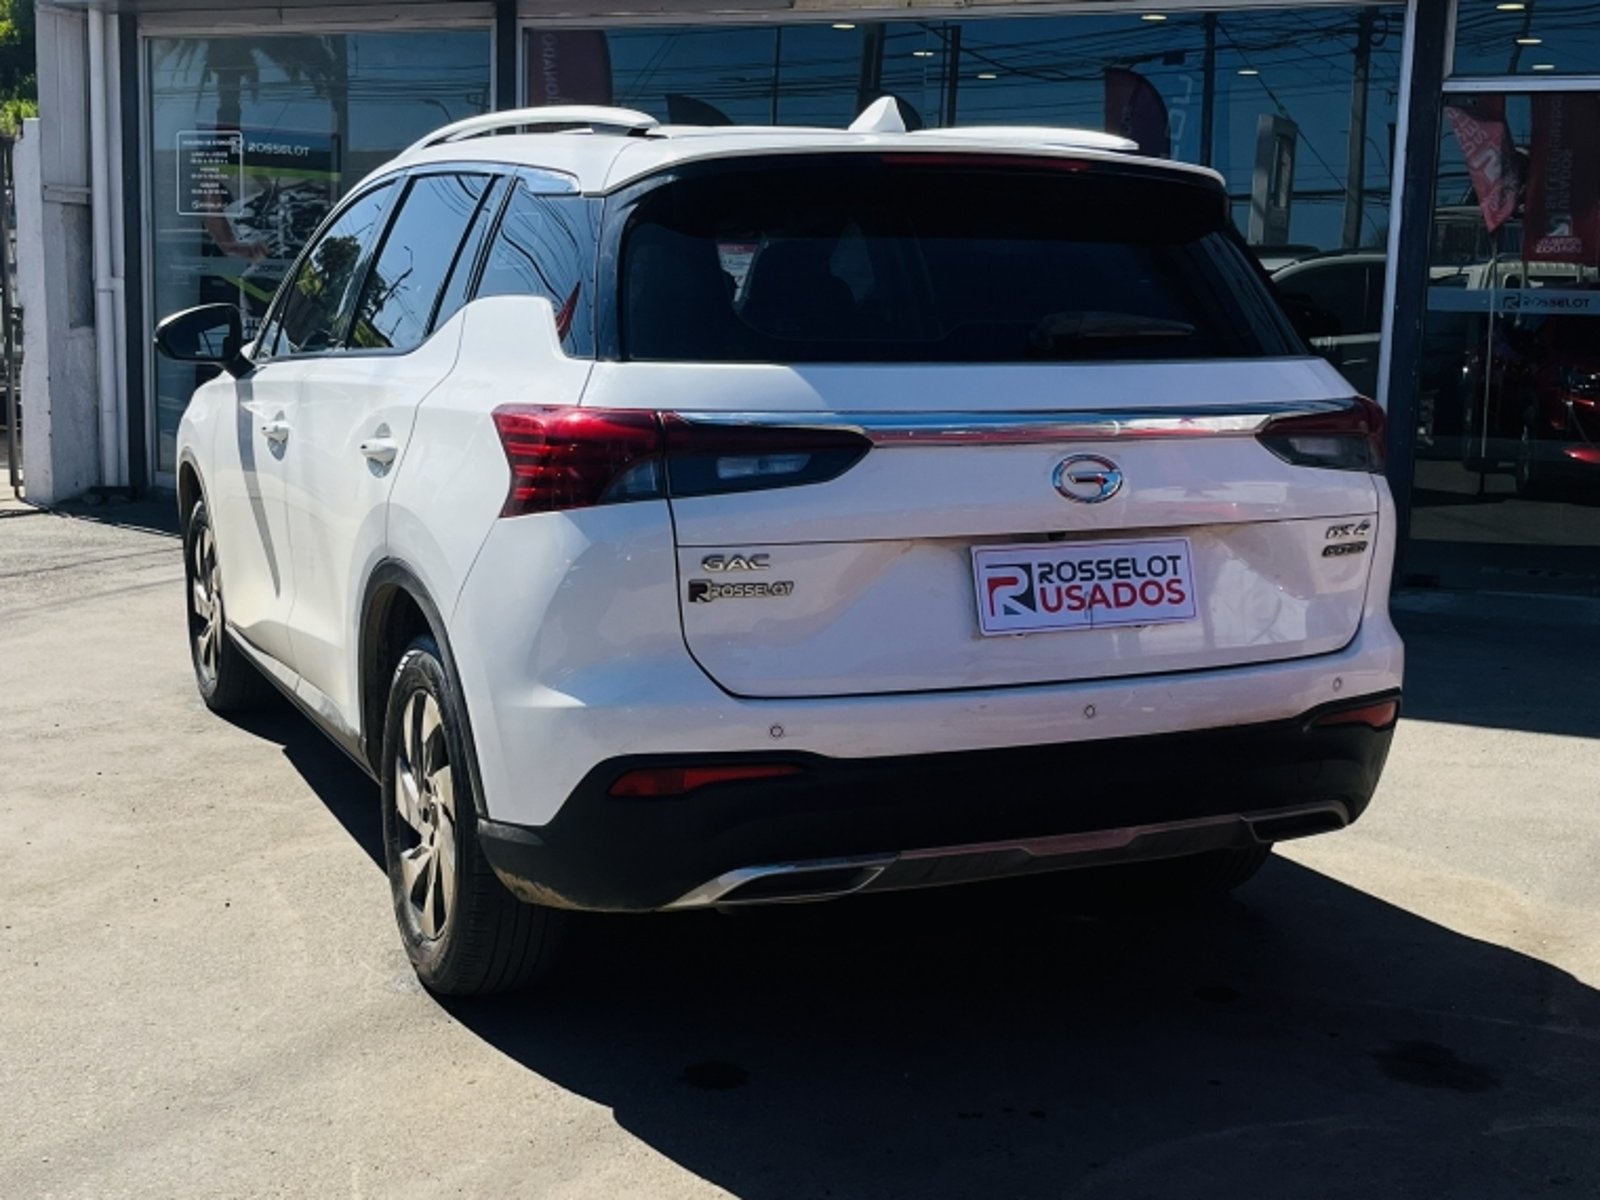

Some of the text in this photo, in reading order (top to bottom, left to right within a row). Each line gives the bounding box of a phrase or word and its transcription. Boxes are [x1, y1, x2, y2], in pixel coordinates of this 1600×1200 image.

[248, 142, 310, 157] ROSSELOT
[702, 553, 770, 572] GAC
[1037, 555, 1182, 584] ROSSELOT
[711, 581, 794, 600] ROSSELOT
[1039, 578, 1186, 613] USADOS
